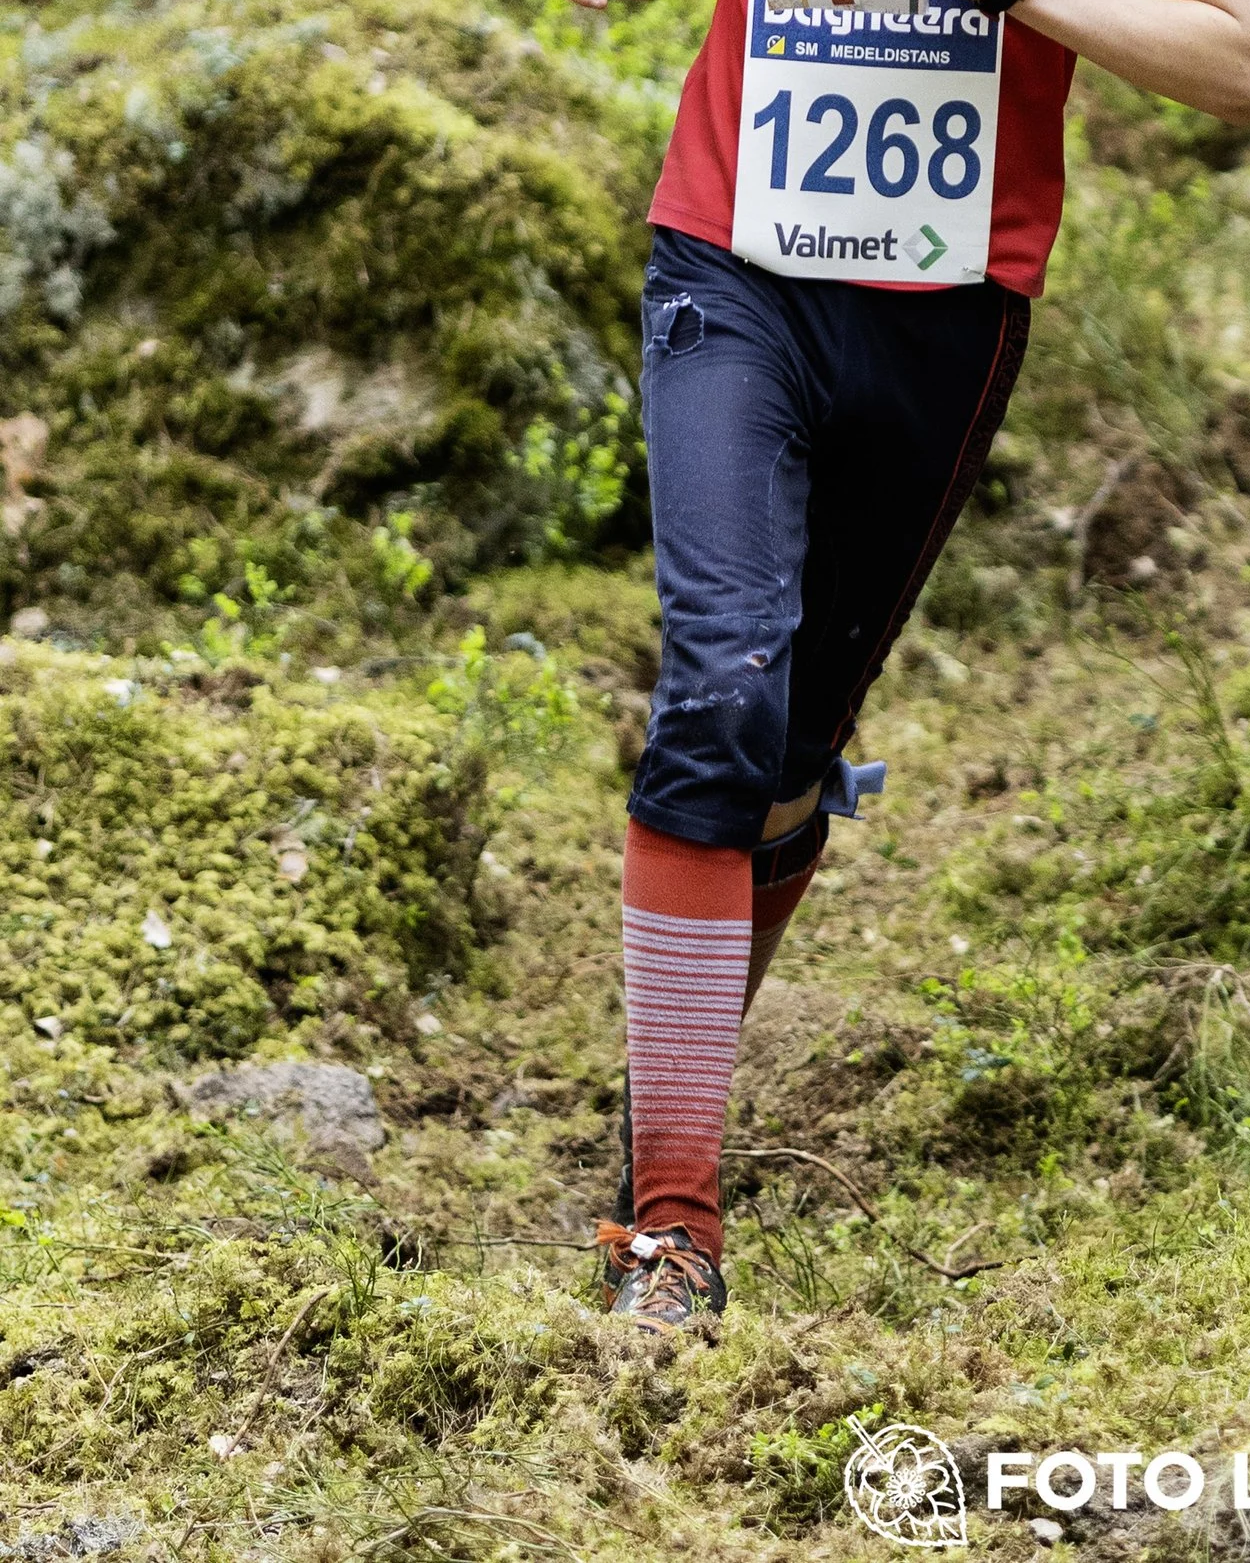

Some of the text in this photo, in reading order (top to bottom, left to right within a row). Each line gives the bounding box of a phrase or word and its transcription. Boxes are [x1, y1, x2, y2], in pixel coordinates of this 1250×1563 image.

[795, 41, 950, 64] SM MEDELDISTANS
[753, 89, 982, 200] 1268
[774, 222, 898, 261] Valmet
